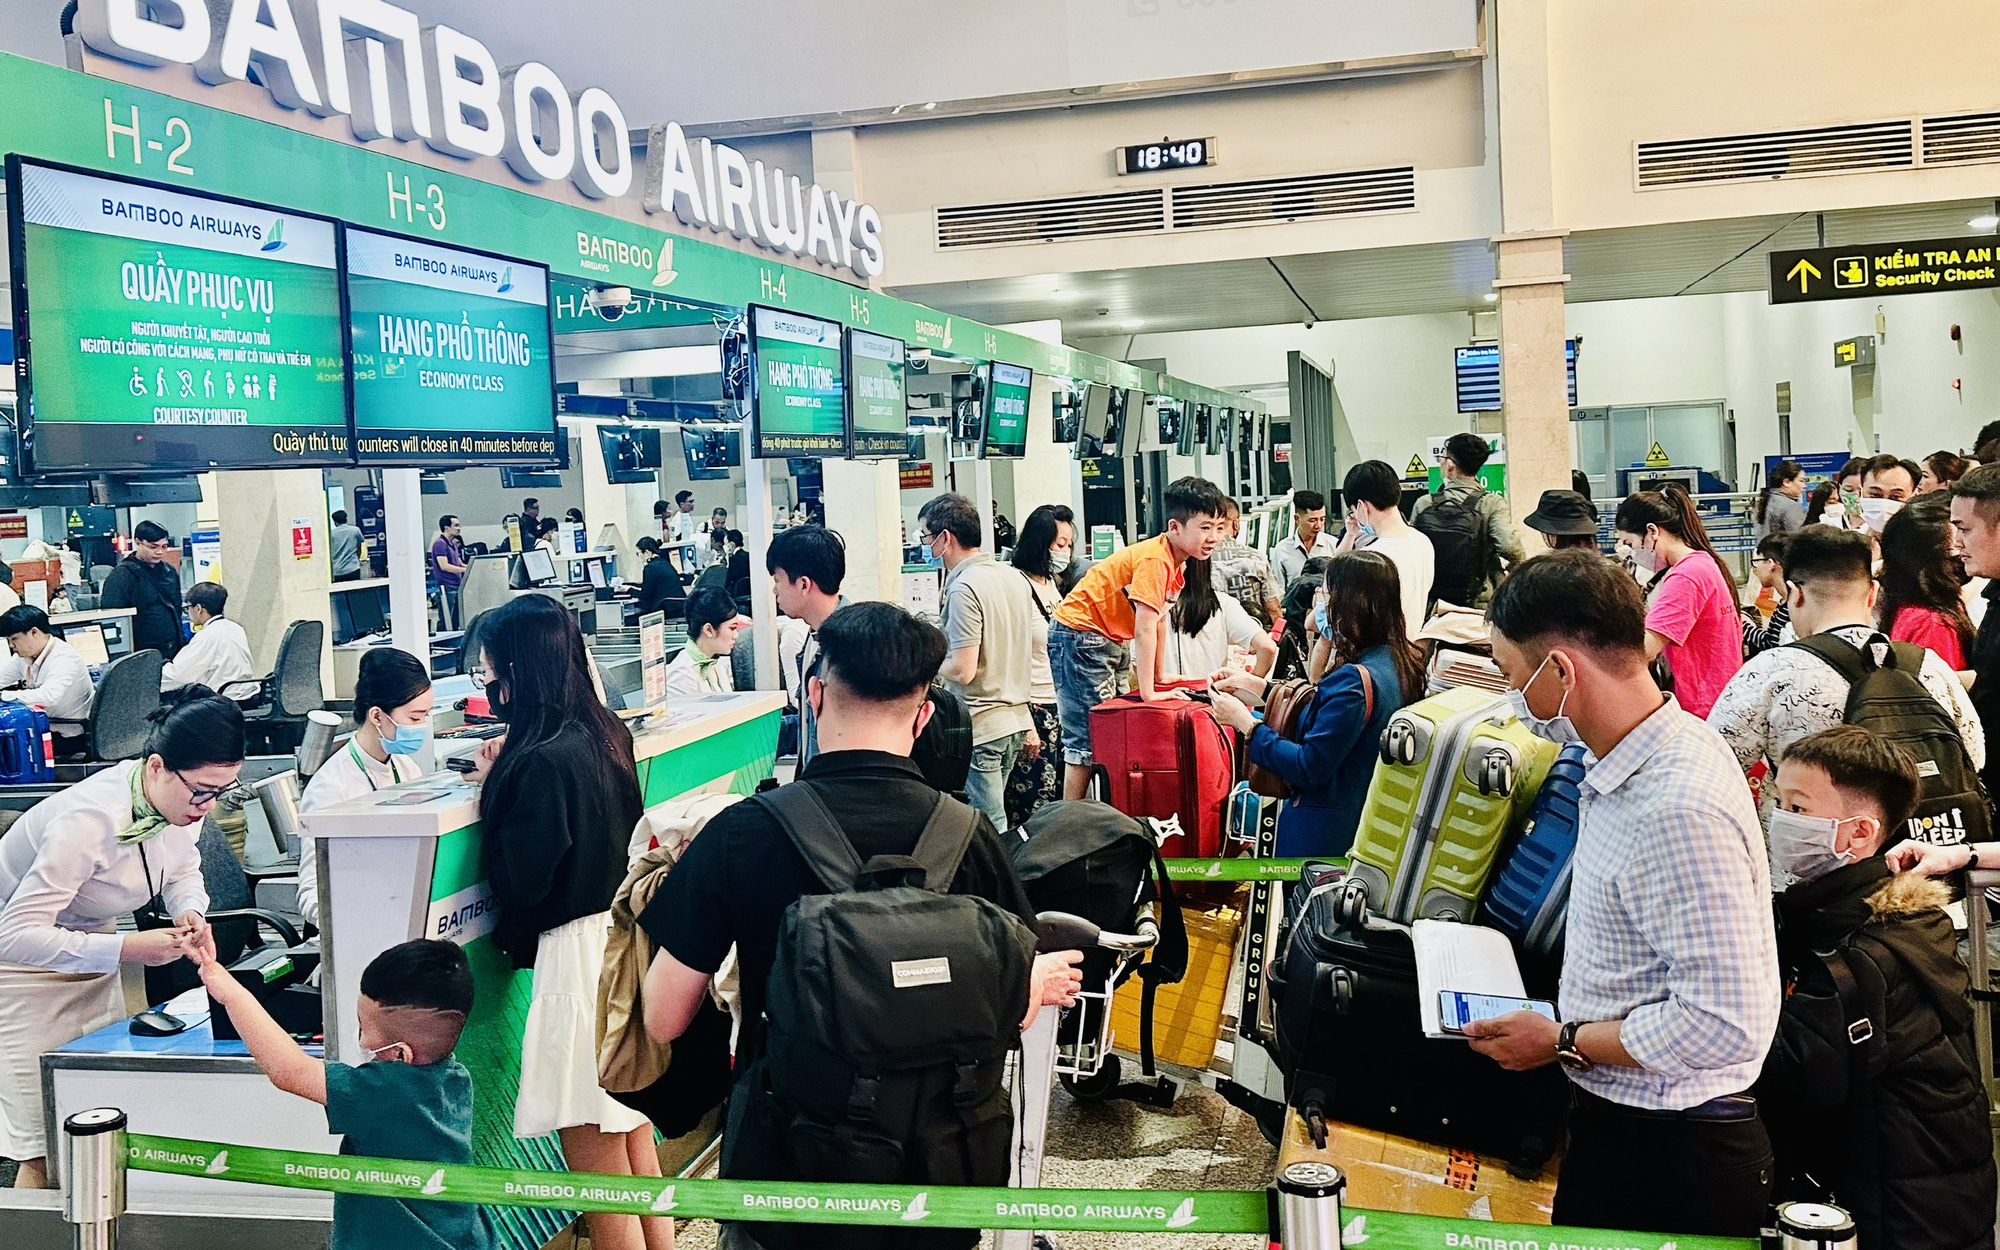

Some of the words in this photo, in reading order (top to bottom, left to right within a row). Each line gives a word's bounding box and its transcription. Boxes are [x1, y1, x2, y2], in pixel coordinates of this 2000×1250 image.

[103, 97, 195, 176] H-2
[1138, 142, 1202, 169] 18:40
[386, 170, 447, 232] H-3
[661, 121, 884, 277] AIRWAYS
[102, 199, 183, 227] BAMBOO
[189, 214, 262, 240] AIRWAYS
[577, 231, 653, 270] BAMBOO
[1875, 248, 1919, 271] KIỂM
[1923, 250, 1962, 266] TRA
[1965, 247, 1991, 263] AN
[394, 253, 447, 275] BAMBOO
[450, 263, 498, 284] AIRWAYS
[580, 259, 610, 273] AIRWAYS
[1875, 271, 1941, 288] Security
[1943, 266, 1996, 283] Check
[121, 251, 183, 305] QUẦY
[186, 271, 244, 318] PHỤC
[245, 278, 274, 323] VỤ
[760, 267, 787, 304] H-4
[849, 293, 870, 325] H-5
[131, 319, 160, 337] NGƯỜI
[237, 331, 252, 345] CAO
[379, 314, 434, 365] HẠNG
[435, 310, 473, 361] PHỔ
[473, 320, 531, 367] THÔNG
[915, 319, 943, 339] BAMBOO
[80, 336, 111, 354] NGƯỜI
[112, 337, 125, 355] CÓ
[126, 338, 151, 356] CÔNG
[168, 341, 190, 359] CÁCH
[300, 354, 312, 366] EM
[984, 331, 997, 355] H-6
[419, 370, 472, 390] ECONOMY
[472, 376, 504, 392] CLASS
[768, 360, 792, 393] HẠNG
[791, 355, 809, 390] PHỔ
[808, 360, 834, 391] THÔNG
[153, 407, 205, 424] COURTESY
[206, 408, 248, 424] COUNTER
[273, 430, 306, 456] Quầy
[308, 430, 329, 451] thủ
[400, 435, 419, 453] will
[420, 435, 448, 453] close
[449, 436, 459, 453] in
[460, 436, 473, 453] 40
[474, 436, 510, 453] minutes
[511, 437, 538, 453] before
[540, 438, 554, 455] dep
[1247, 933, 1264, 1002] GROUP
[144, 1149, 206, 1167] AIRWAYS
[285, 1163, 350, 1180] BAMBOO
[355, 1169, 422, 1187] AIRWAYS
[505, 1182, 575, 1198] BAMBOO
[580, 1187, 652, 1203] AIRWAYS
[743, 1194, 820, 1210] BAMBOO
[824, 1197, 902, 1212] AIRWAYS
[996, 1202, 1078, 1218] BAMBOO
[1083, 1204, 1166, 1220] AIRWAYS
[1445, 1232, 1540, 1250] BAMBOO
